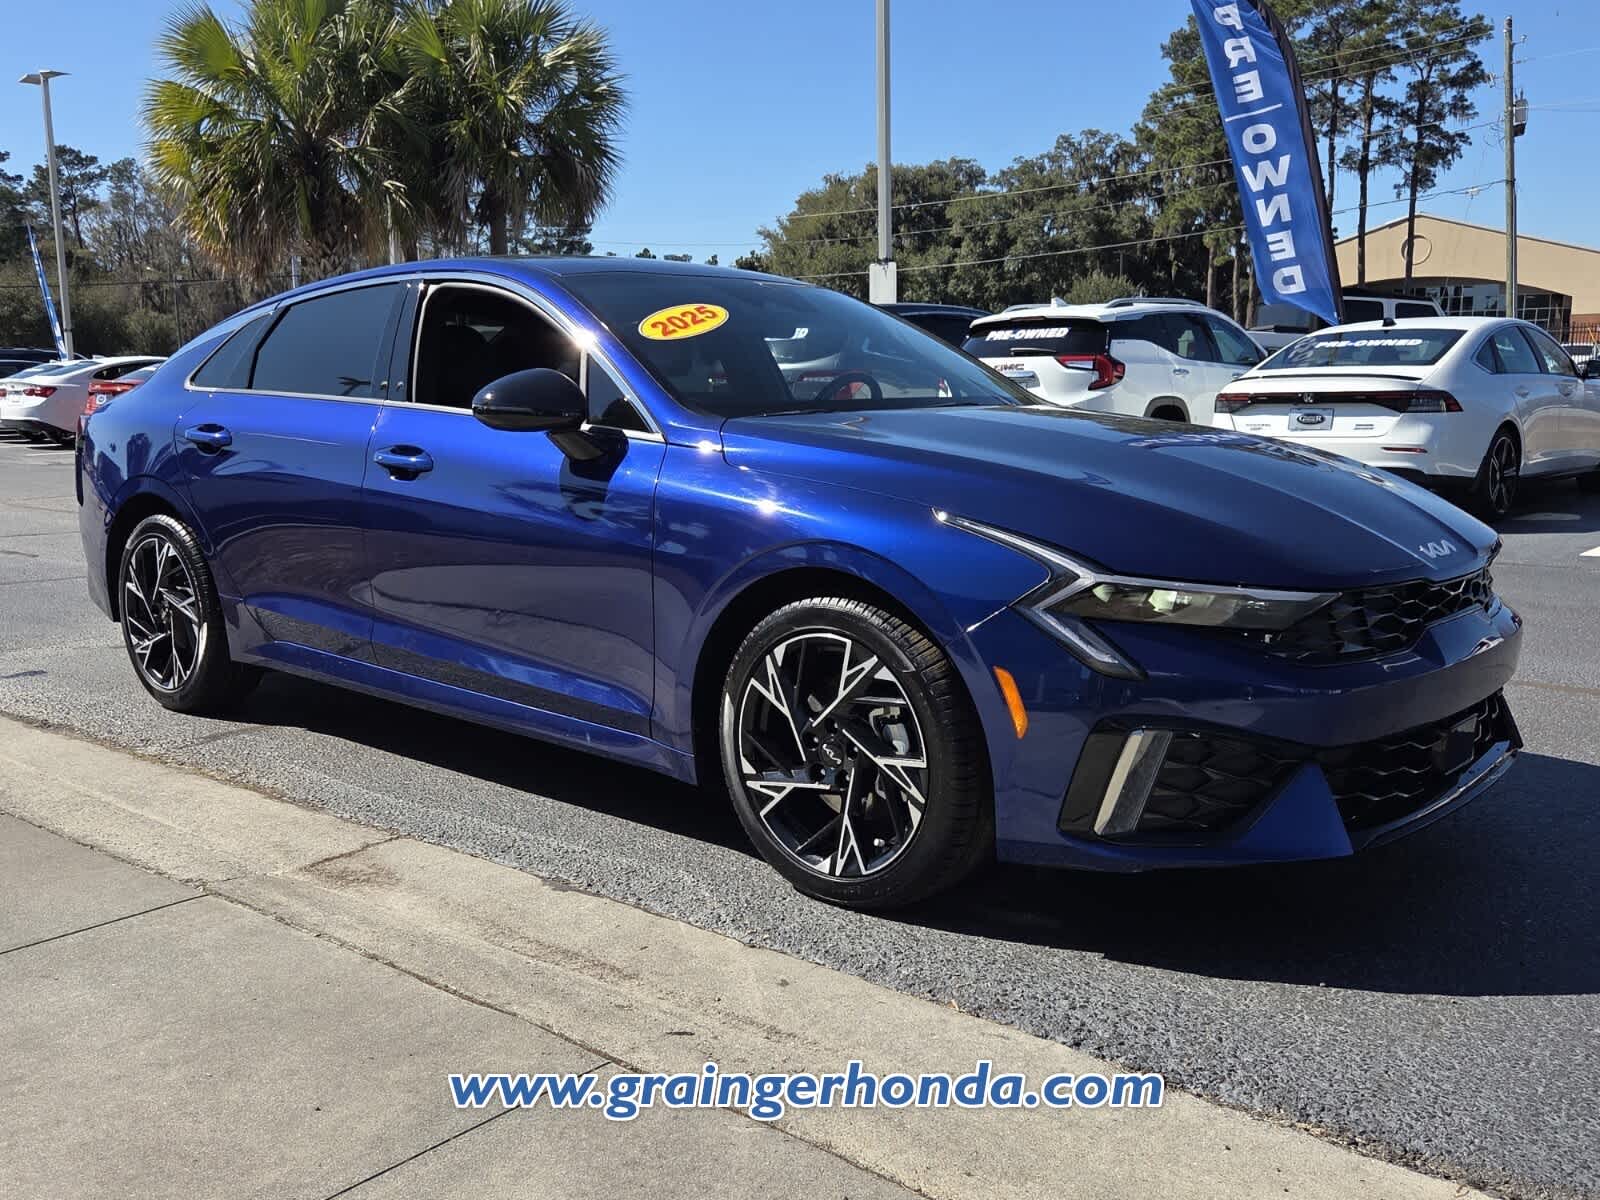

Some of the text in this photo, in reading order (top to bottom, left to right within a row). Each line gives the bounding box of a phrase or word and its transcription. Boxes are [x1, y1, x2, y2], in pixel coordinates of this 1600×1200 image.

[651, 306, 718, 336] 2025
[985, 327, 1069, 341] PRE-OWNED
[1315, 338, 1423, 349] PRE-OWNED
